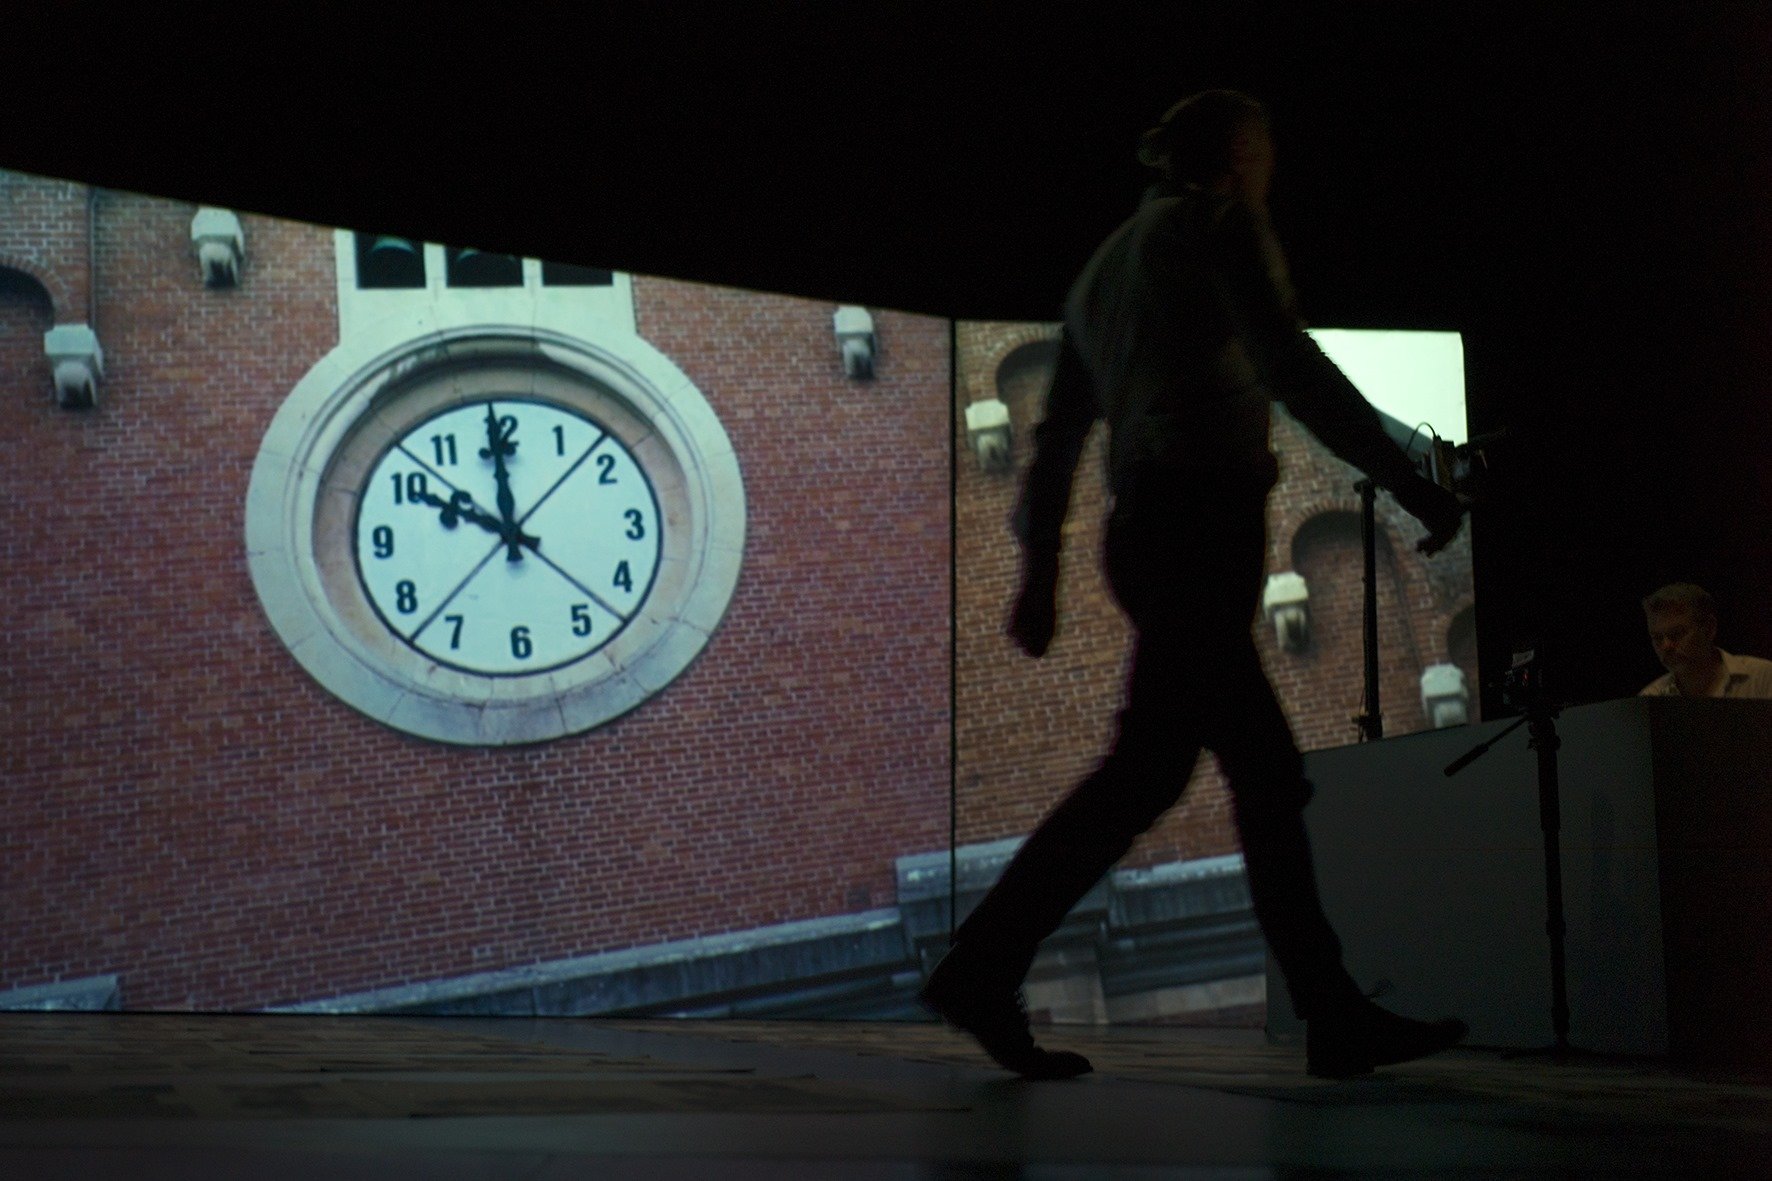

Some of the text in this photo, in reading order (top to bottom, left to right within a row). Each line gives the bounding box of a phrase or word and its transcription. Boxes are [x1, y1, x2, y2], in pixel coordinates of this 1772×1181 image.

[431, 434, 457, 466] 11
[552, 425, 565, 456] 1
[596, 454, 617, 485] 2
[391, 472, 428, 505] 10
[624, 509, 645, 541] 3
[372, 525, 394, 559] 9
[613, 561, 632, 593] 4
[395, 580, 418, 614] 8
[445, 615, 464, 650] 7
[570, 604, 592, 637] 5
[510, 626, 532, 660] 6
